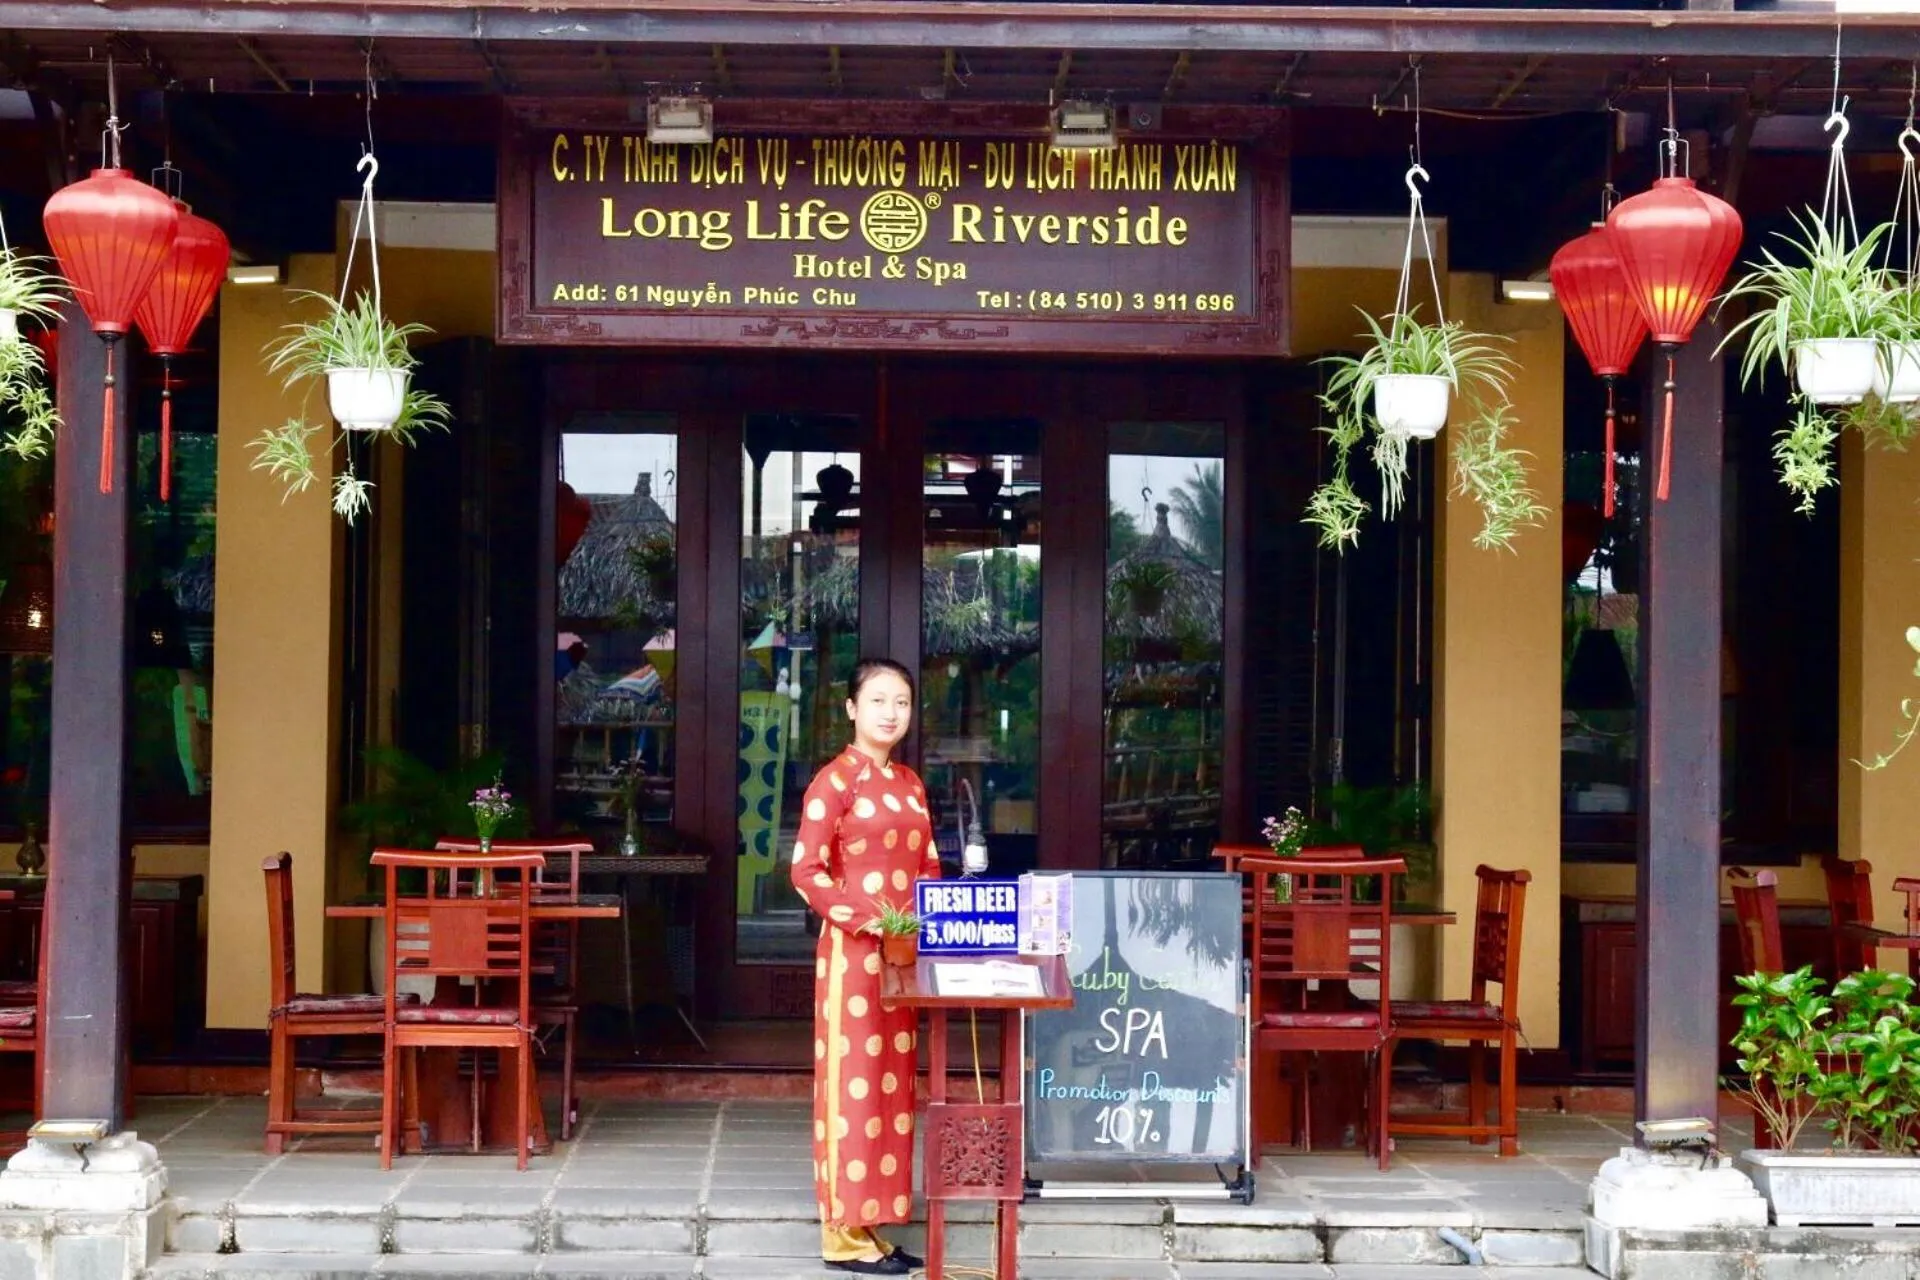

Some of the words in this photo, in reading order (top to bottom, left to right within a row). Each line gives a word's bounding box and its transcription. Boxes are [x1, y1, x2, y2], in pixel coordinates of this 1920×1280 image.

[552, 134, 575, 183] C.
[583, 136, 609, 183] TY
[623, 137, 678, 183] TNHH
[690, 138, 744, 189] DỊCH
[757, 139, 788, 190] VỤ
[813, 135, 906, 187] THƯƠNG
[918, 141, 960, 192] MẠI
[984, 143, 1015, 190] DU
[1026, 142, 1076, 194] LỊCH
[1088, 144, 1161, 191] THANH
[1173, 139, 1237, 192] XUÂN
[601, 198, 733, 250] Long
[746, 199, 850, 240] Life
[949, 203, 1188, 246] Riverside
[793, 254, 872, 279] Hotel
[881, 256, 906, 279] &
[916, 256, 967, 286] Spa
[553, 283, 607, 302] Add:
[615, 285, 638, 302] 61
[647, 282, 732, 307] Nguyễn
[744, 286, 799, 305] Phúc
[813, 288, 856, 305] Chu
[1028, 290, 1067, 311] (84
[1076, 291, 1123, 312] 510)
[1133, 292, 1145, 310] 3
[1153, 293, 1187, 311] 911
[1195, 294, 1235, 312] 696
[924, 887, 973, 913] FRESH
[975, 887, 1016, 913] BEER
[926, 918, 1015, 946] 5.000/glass
[1095, 1007, 1168, 1059] SPA
[1039, 1068, 1133, 1099] Promotion
[1094, 1105, 1161, 1144] 10%
